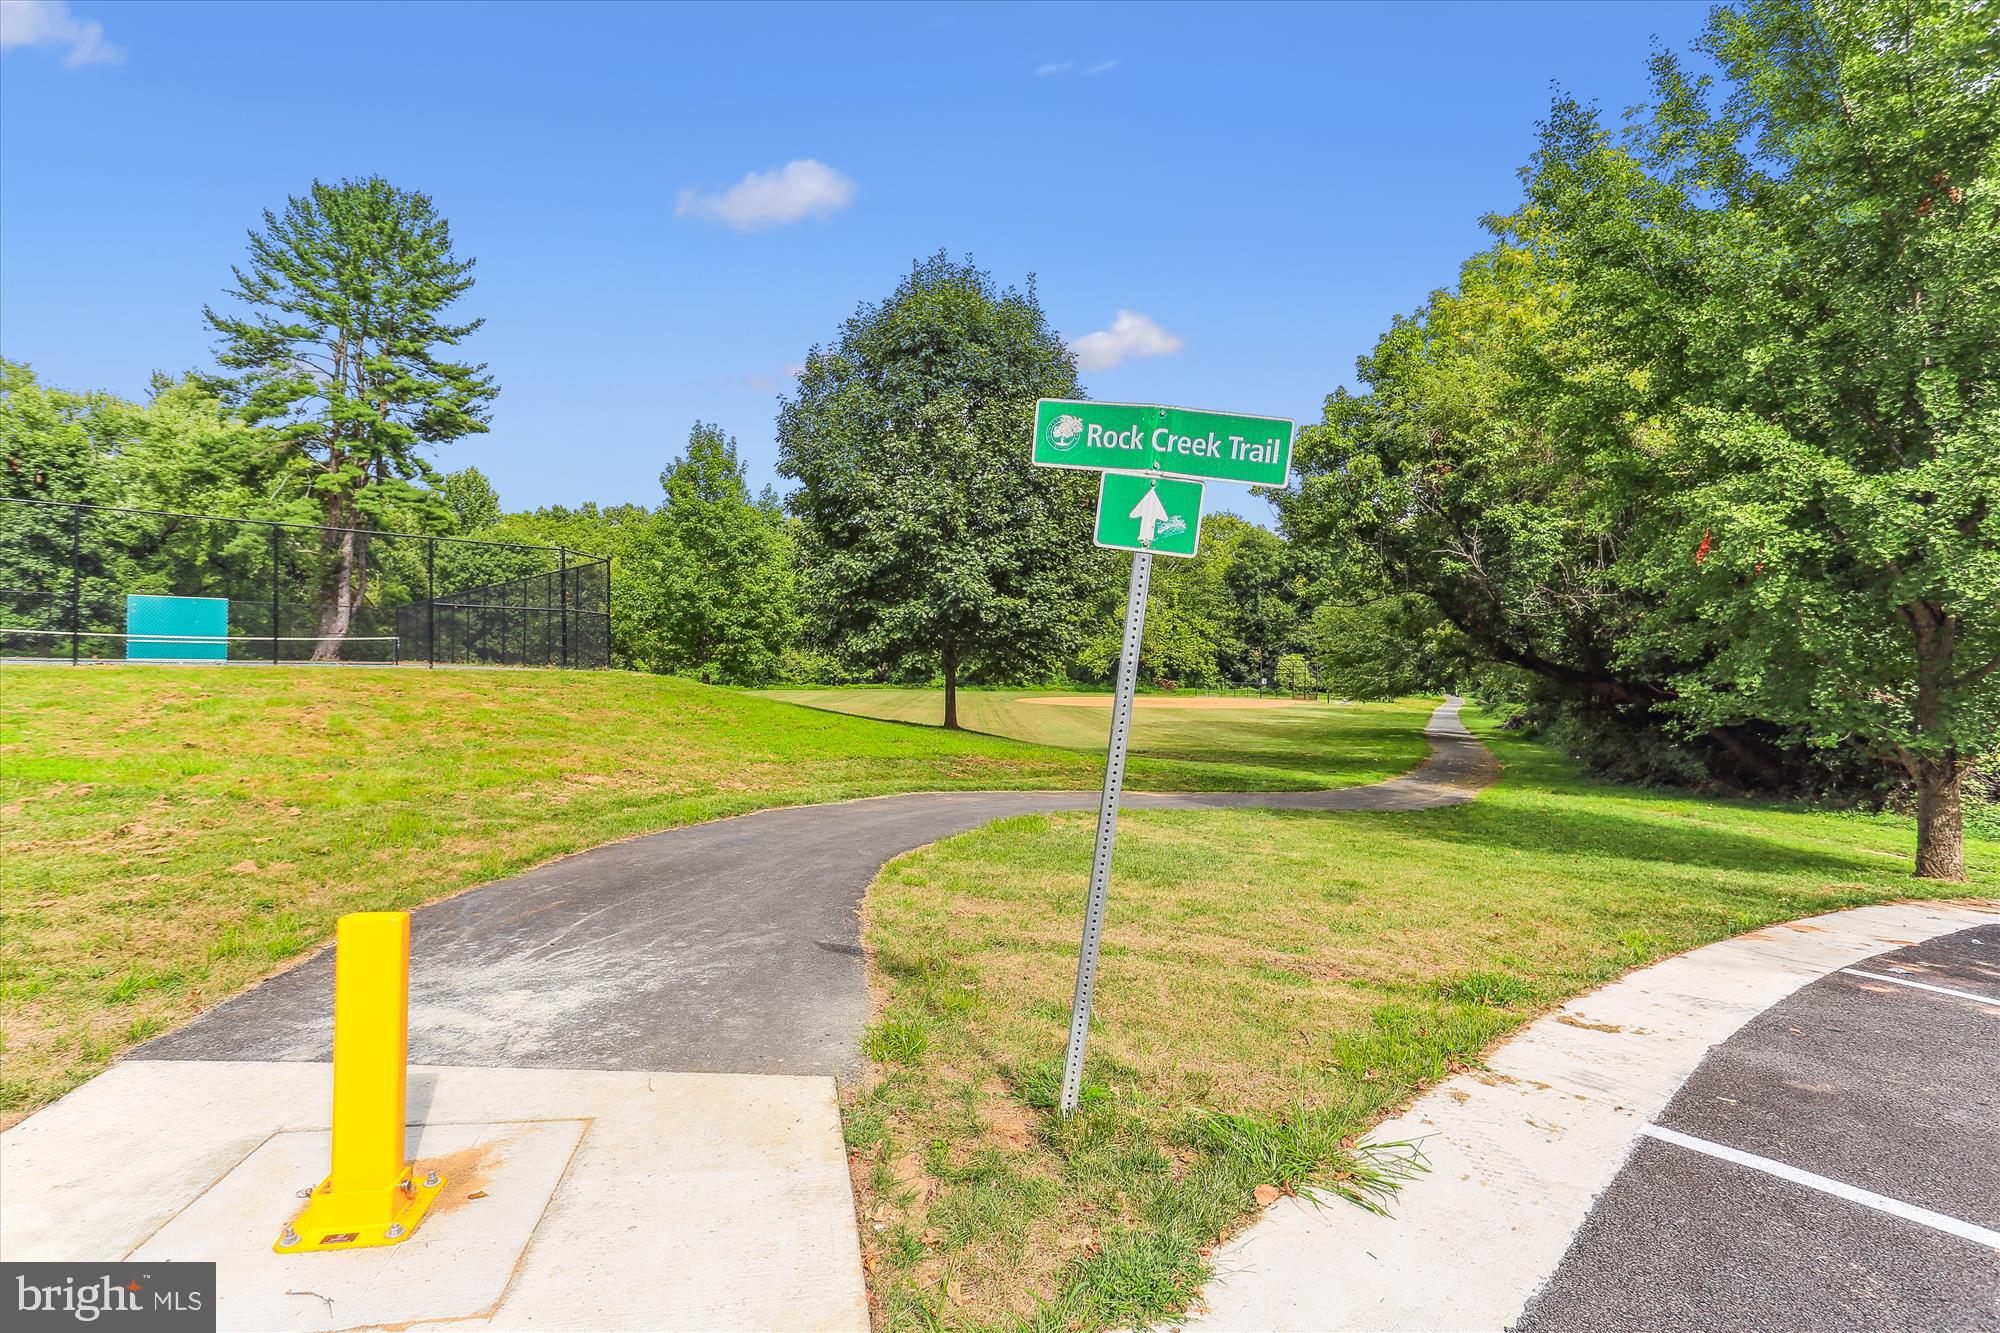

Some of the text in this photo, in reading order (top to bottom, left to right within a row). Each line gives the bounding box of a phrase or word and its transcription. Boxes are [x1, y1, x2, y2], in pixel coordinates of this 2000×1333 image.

[1087, 424, 1144, 450] Rock
[1152, 428, 1221, 458] Creek
[1228, 436, 1280, 464] Trail
